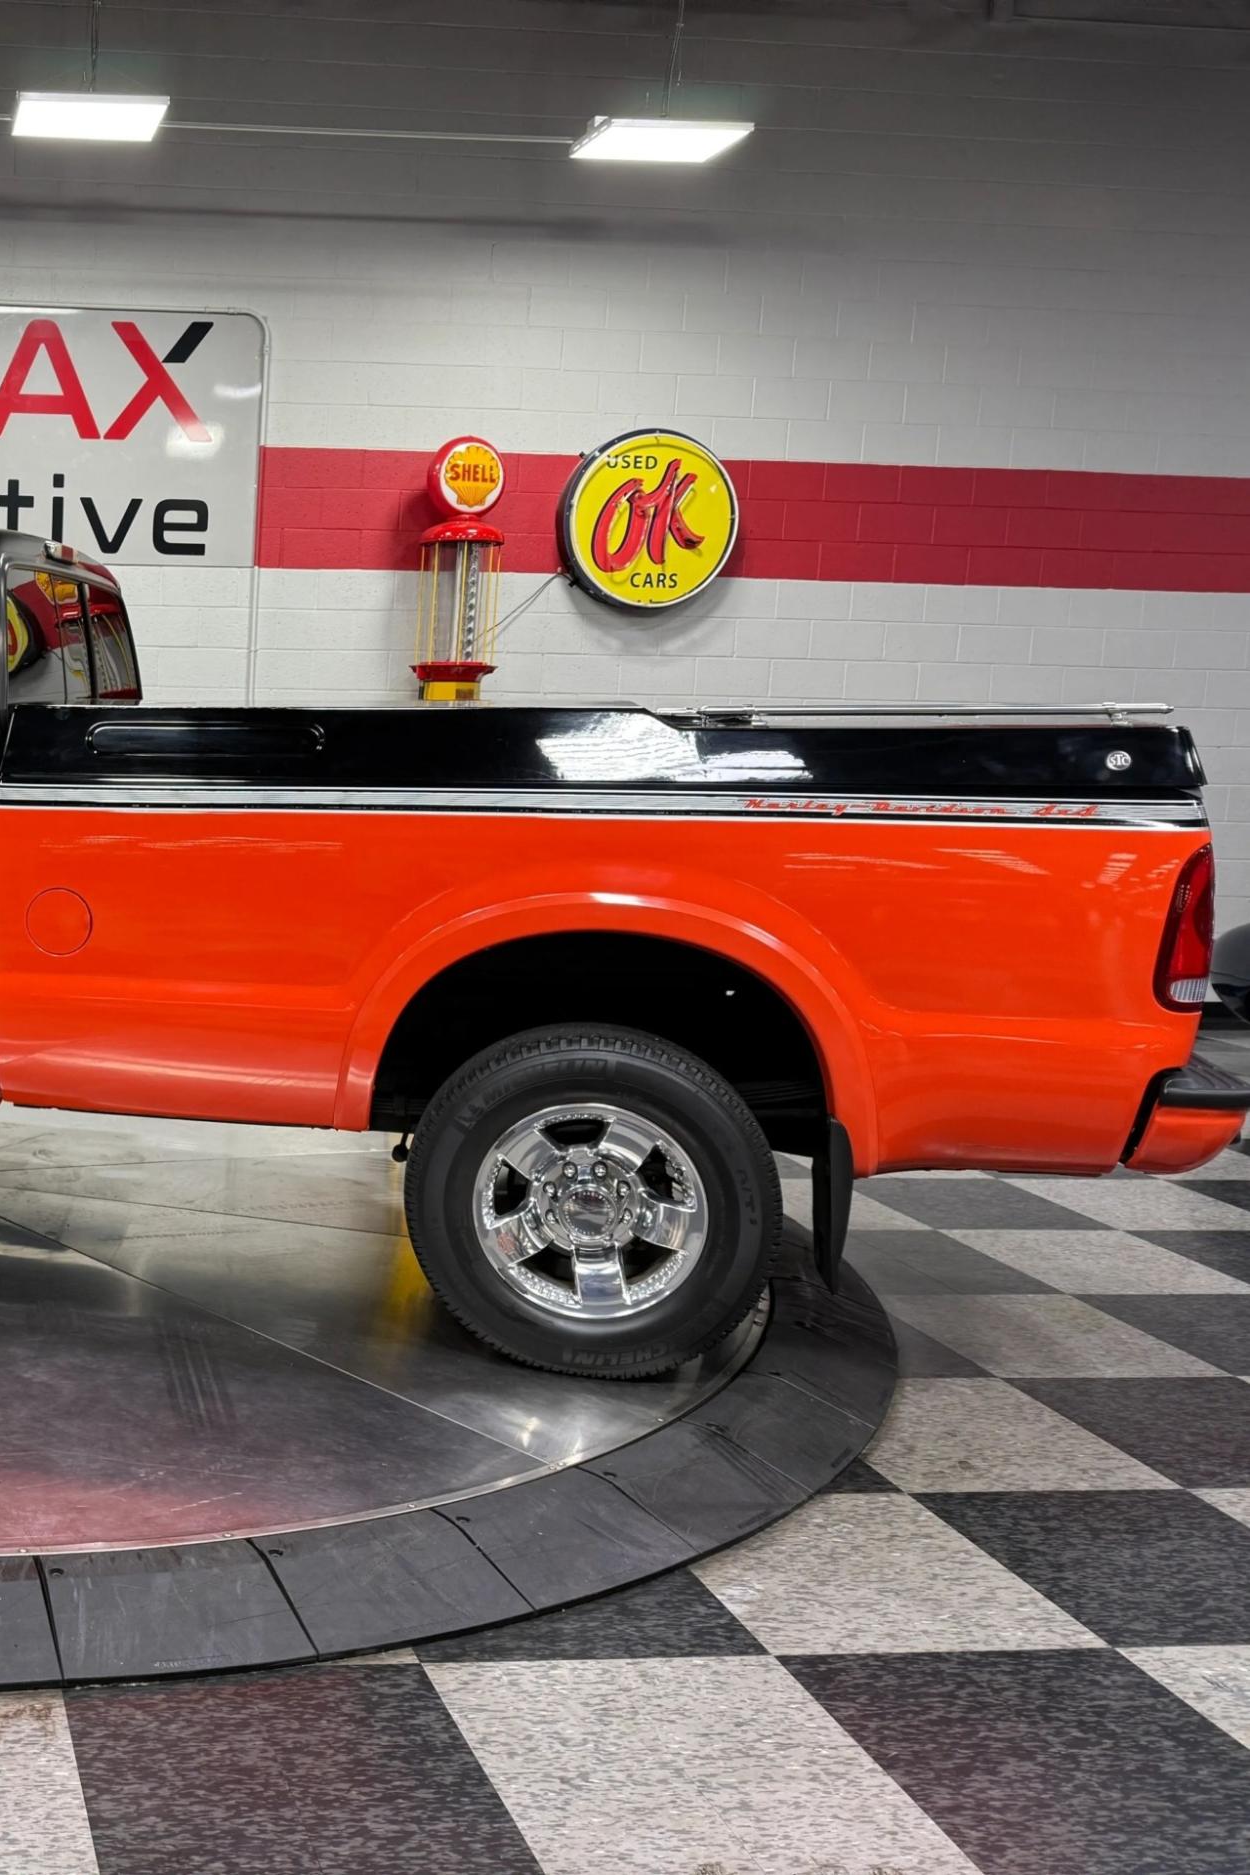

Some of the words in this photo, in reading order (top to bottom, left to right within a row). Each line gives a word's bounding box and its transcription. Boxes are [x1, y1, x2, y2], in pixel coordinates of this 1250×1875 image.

[606, 454, 659, 470] USED
[449, 463, 497, 485] SHELL
[591, 458, 705, 573] OK
[629, 572, 679, 589] CARS
[744, 796, 1009, 816] Harley-Davidson
[1031, 802, 1100, 817] 4x4
